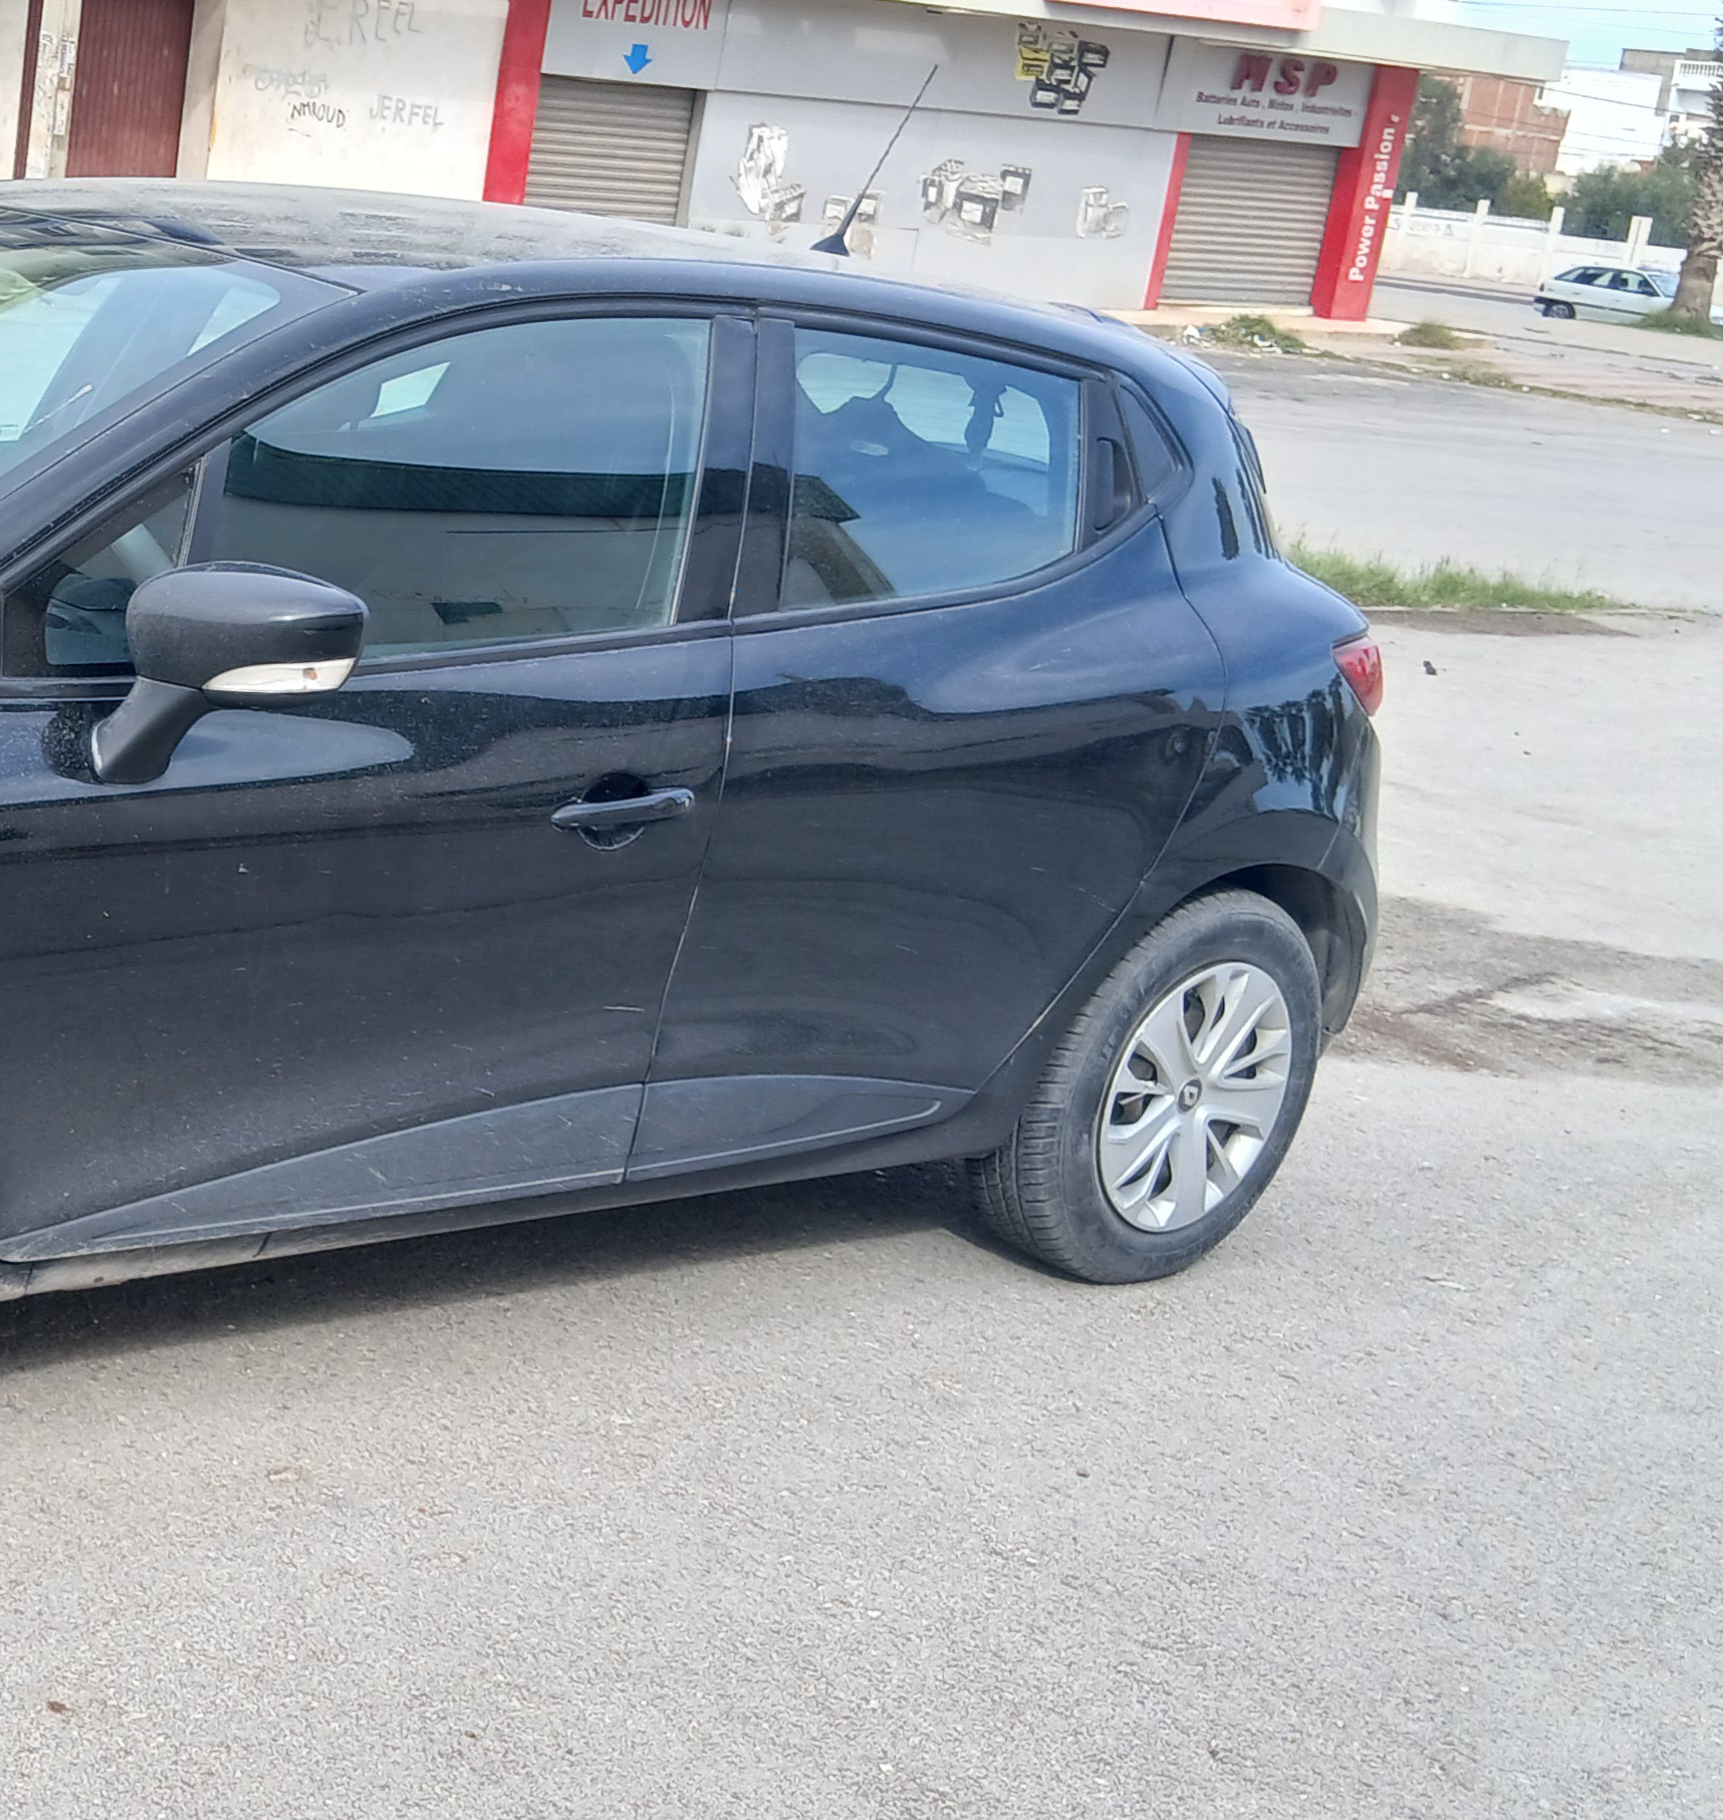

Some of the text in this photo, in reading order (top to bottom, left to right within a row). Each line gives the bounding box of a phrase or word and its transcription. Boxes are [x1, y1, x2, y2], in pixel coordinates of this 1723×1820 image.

[1230, 54, 1338, 98] MSP
[1348, 126, 1396, 283] Power Passion
